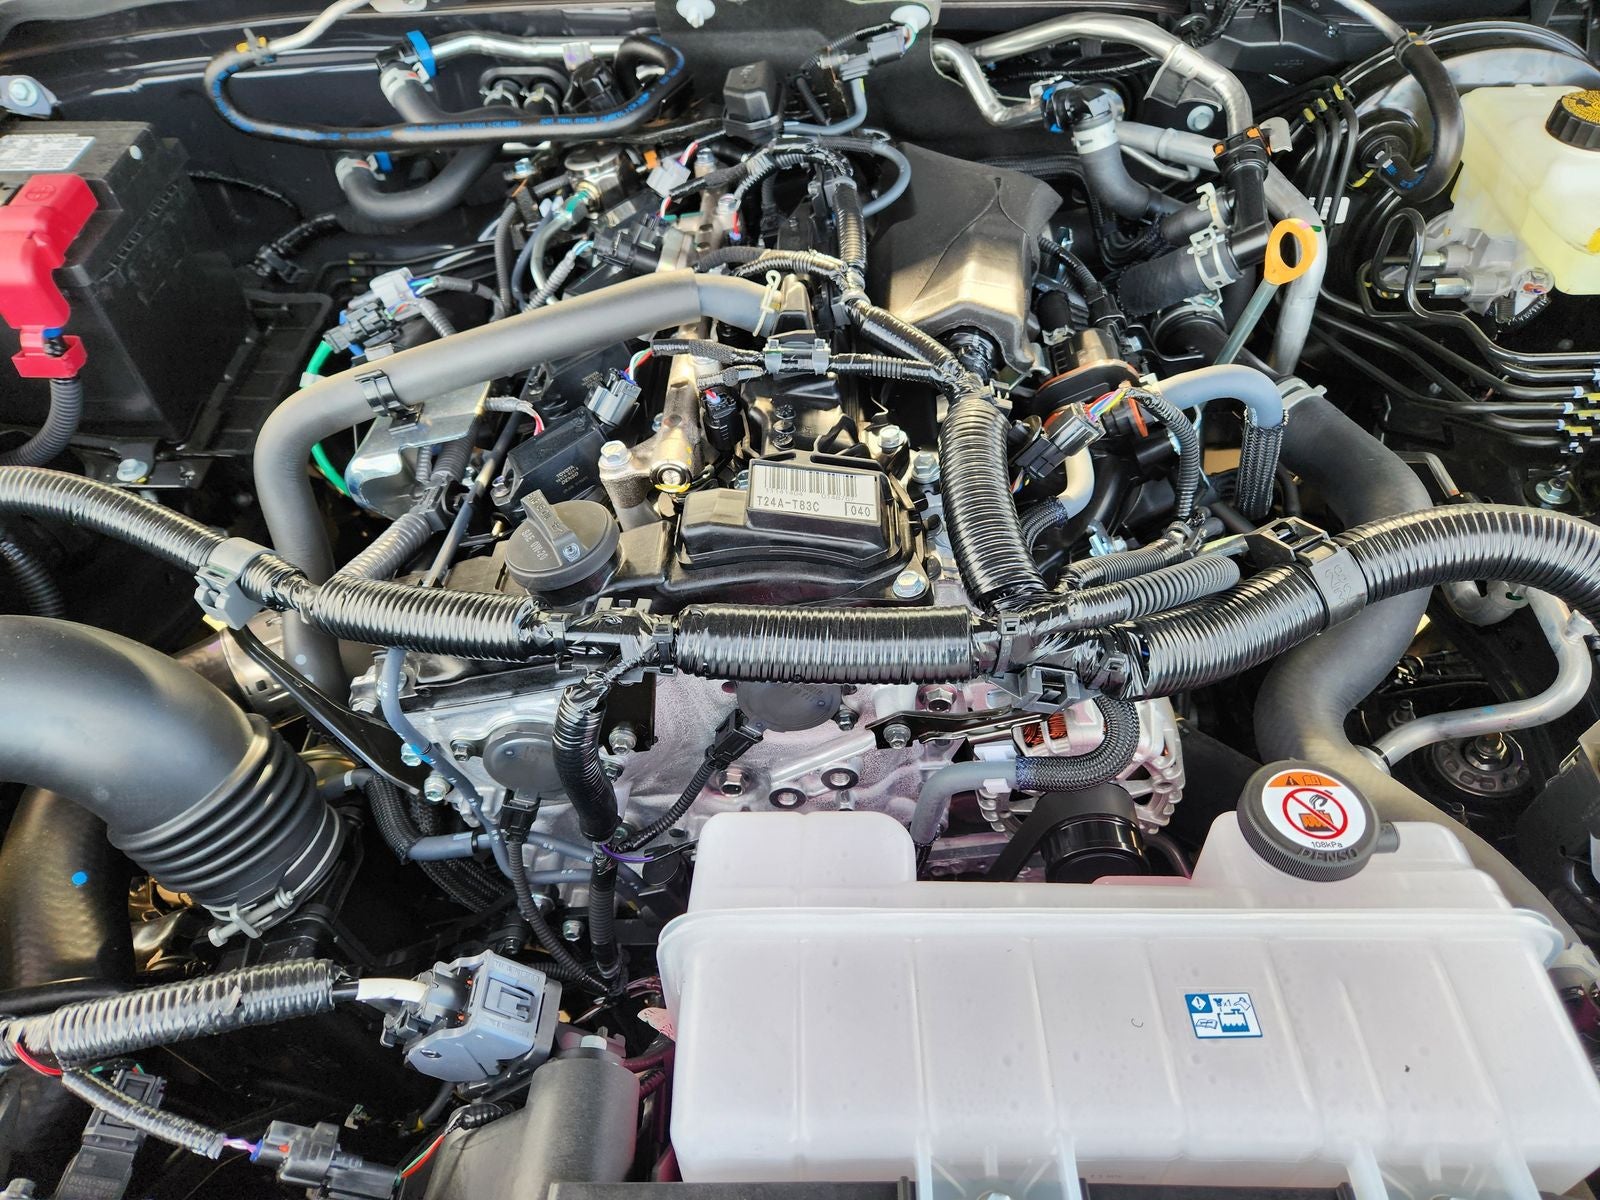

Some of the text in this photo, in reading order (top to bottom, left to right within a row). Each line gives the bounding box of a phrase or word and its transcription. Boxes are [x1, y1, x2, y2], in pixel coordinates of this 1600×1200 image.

[851, 505, 871, 517] 040
[521, 528, 536, 543] SAE
[1311, 840, 1343, 849] 108kPa
[1298, 847, 1358, 862] DENSO
